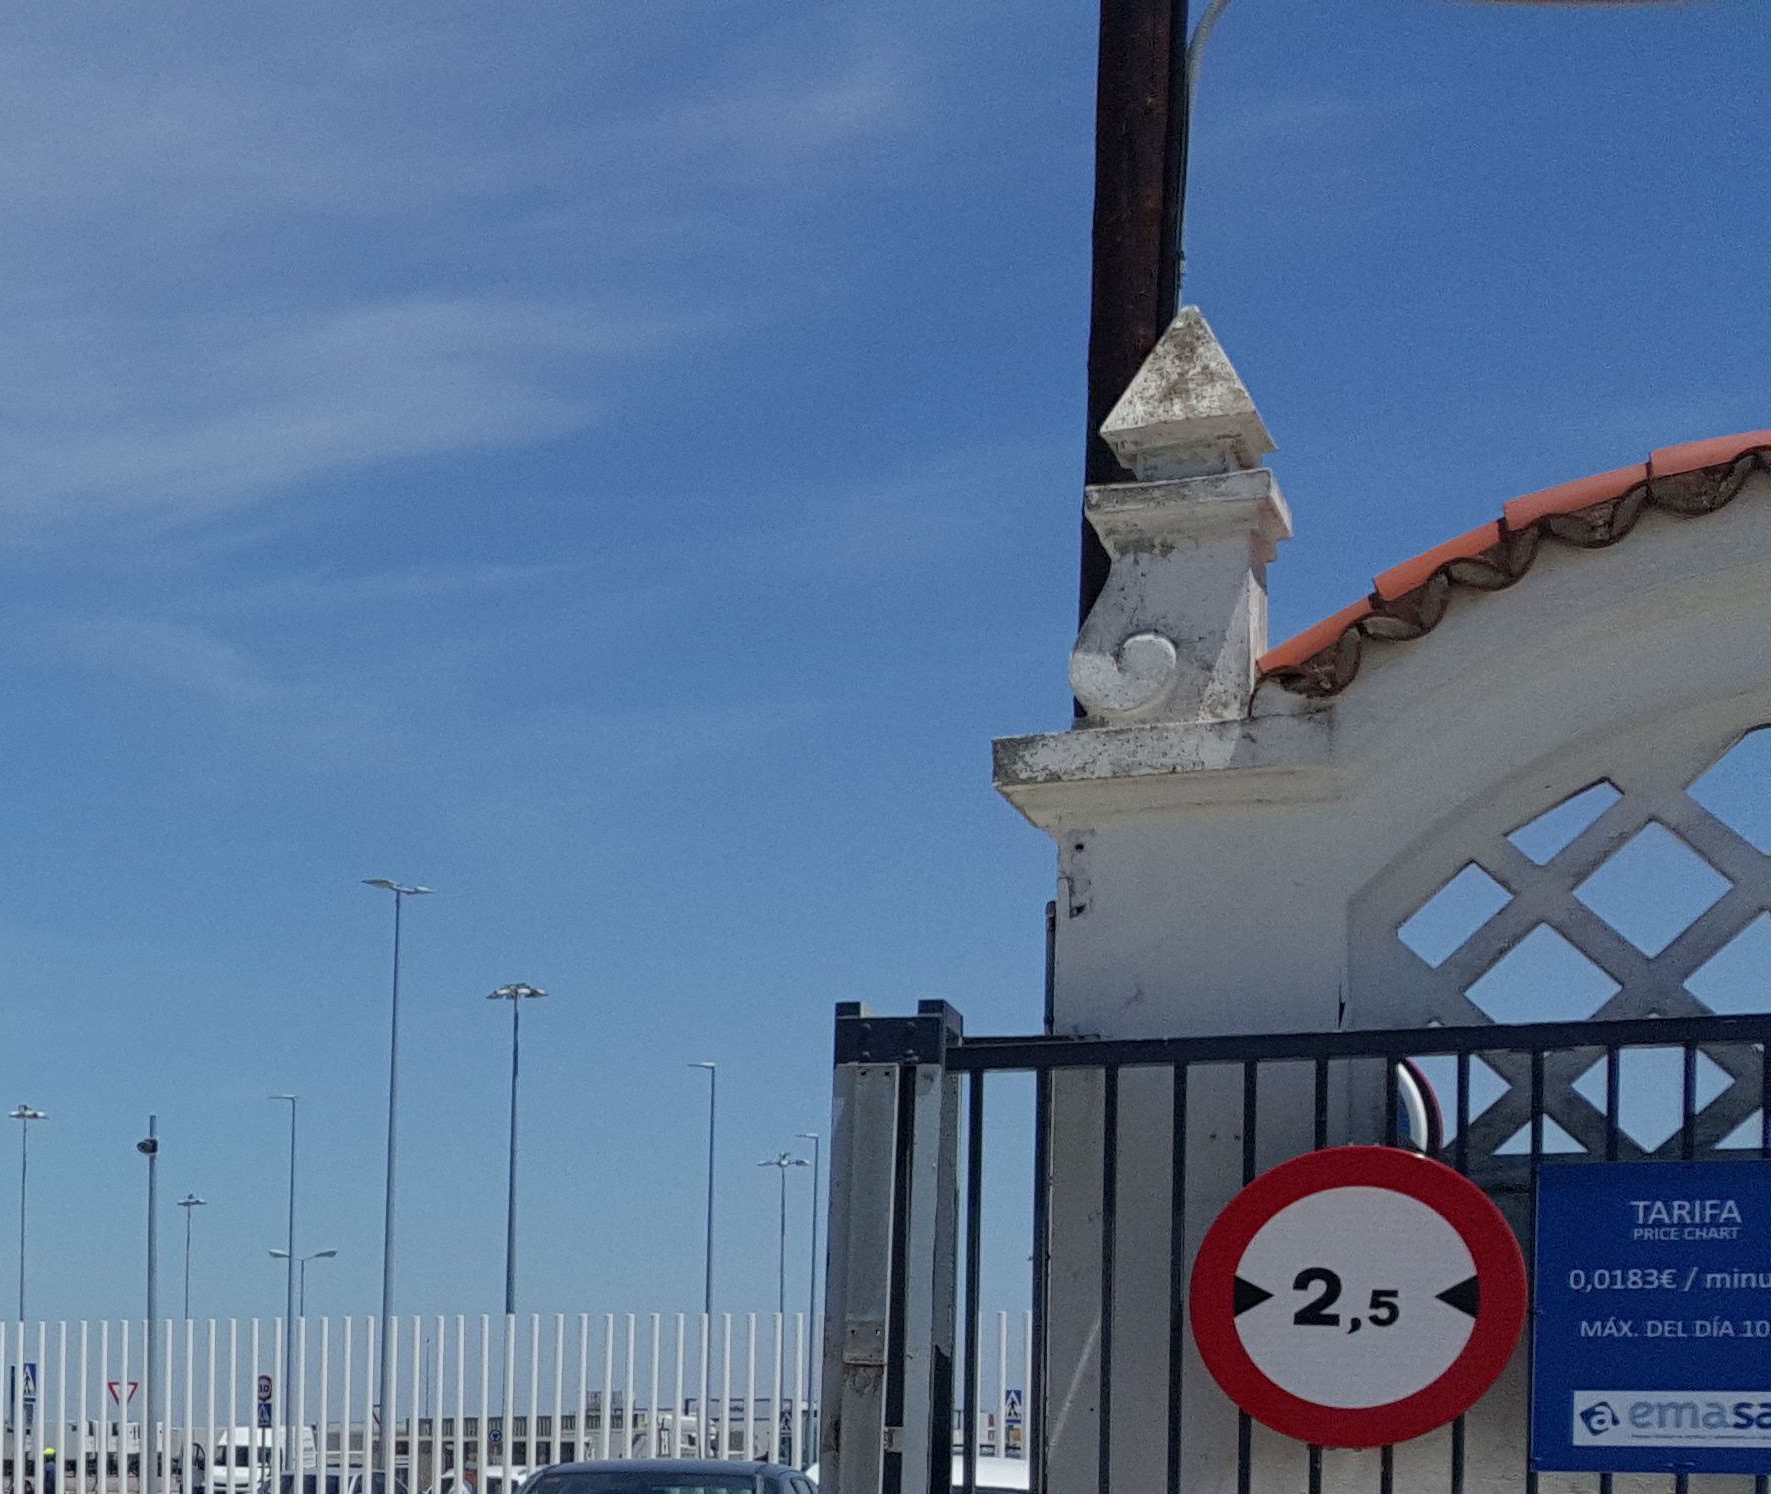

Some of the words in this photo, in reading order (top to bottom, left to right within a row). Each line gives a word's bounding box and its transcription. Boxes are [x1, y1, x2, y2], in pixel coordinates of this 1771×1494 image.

[1631, 1200, 1742, 1225] TARIFA
[1633, 1228, 1681, 1241] PRICE
[1684, 1227, 1739, 1240] CHART
[1569, 1269, 1677, 1293] 0,0183€
[1291, 1267, 1400, 1334] 2,5
[1580, 1315, 1639, 1338] MÁX.
[1646, 1320, 1688, 1338] DEL
[1695, 1315, 1735, 1338] DÍA
